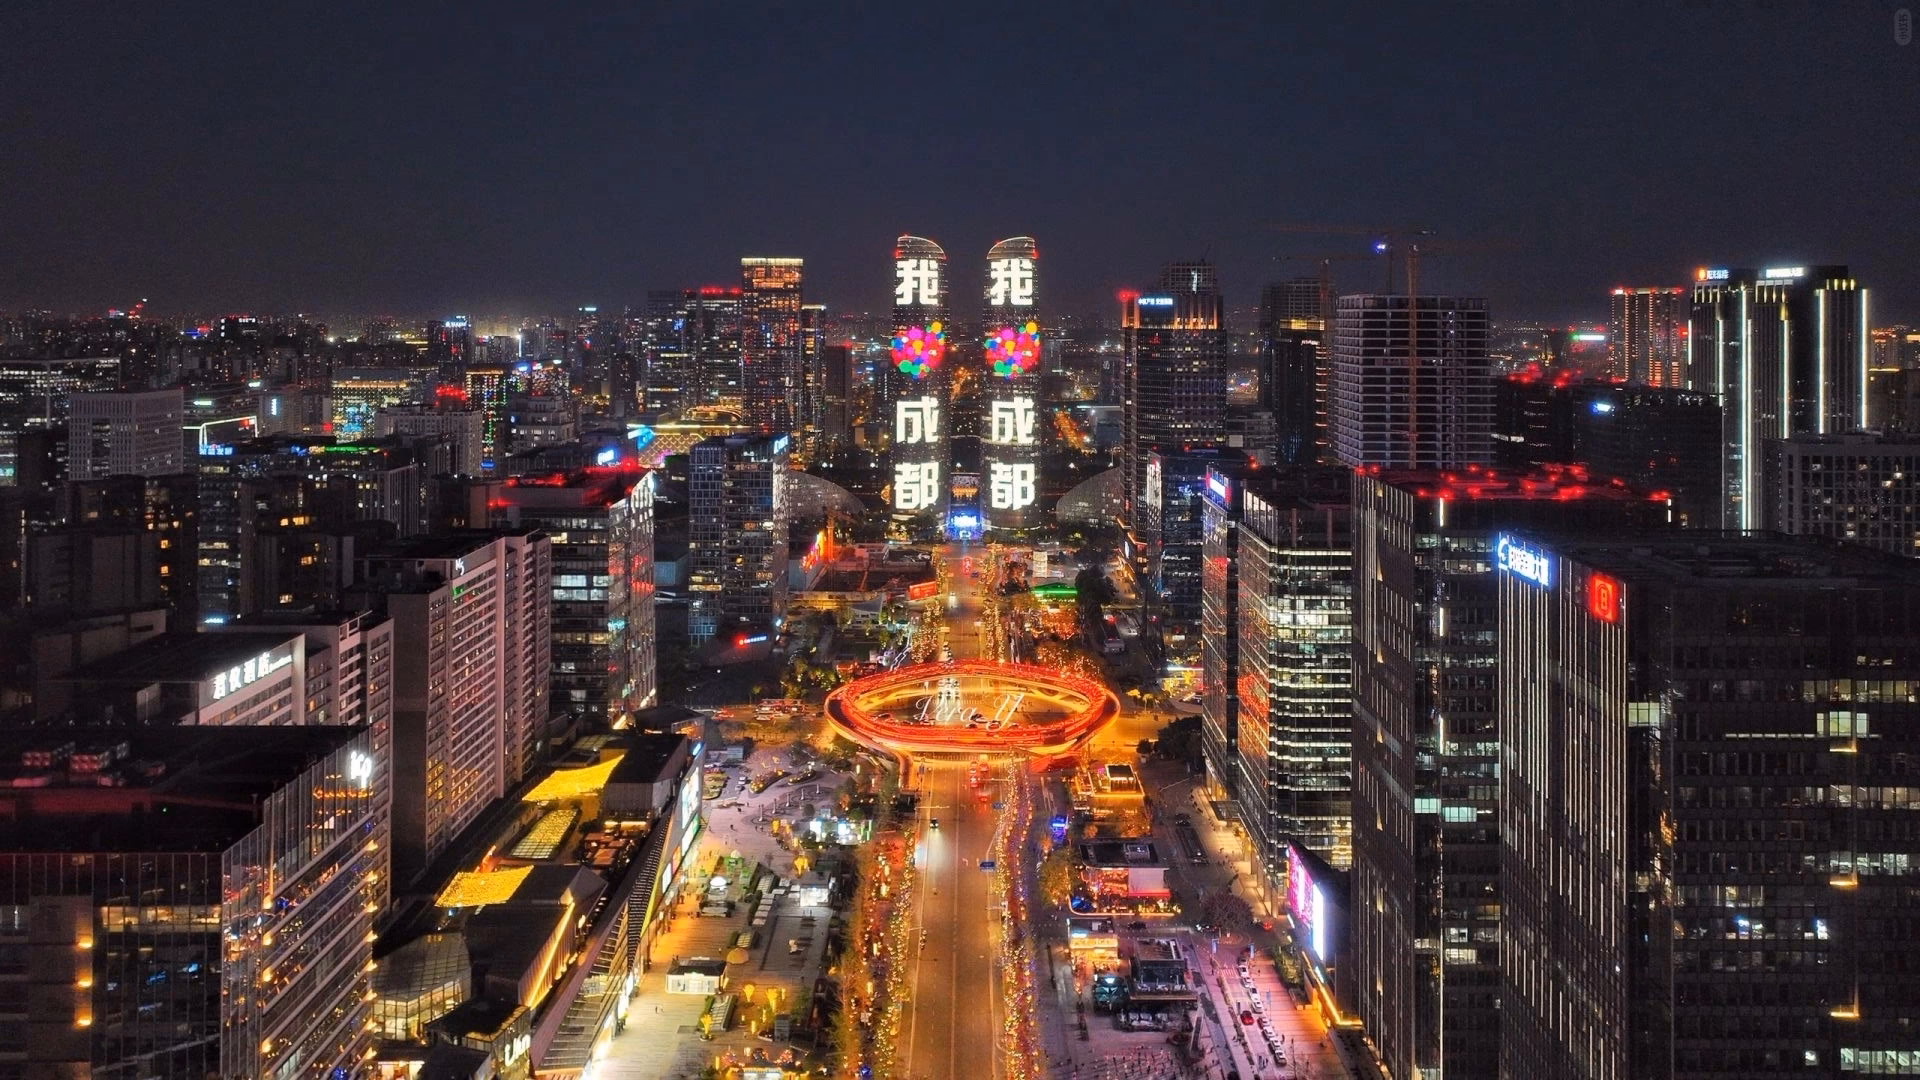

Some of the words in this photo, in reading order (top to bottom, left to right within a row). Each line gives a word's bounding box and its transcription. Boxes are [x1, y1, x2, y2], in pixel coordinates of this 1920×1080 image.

[896, 259, 938, 305] 我
[991, 258, 1033, 305] 我
[894, 397, 938, 509] 成都
[990, 397, 1035, 509] 成都
